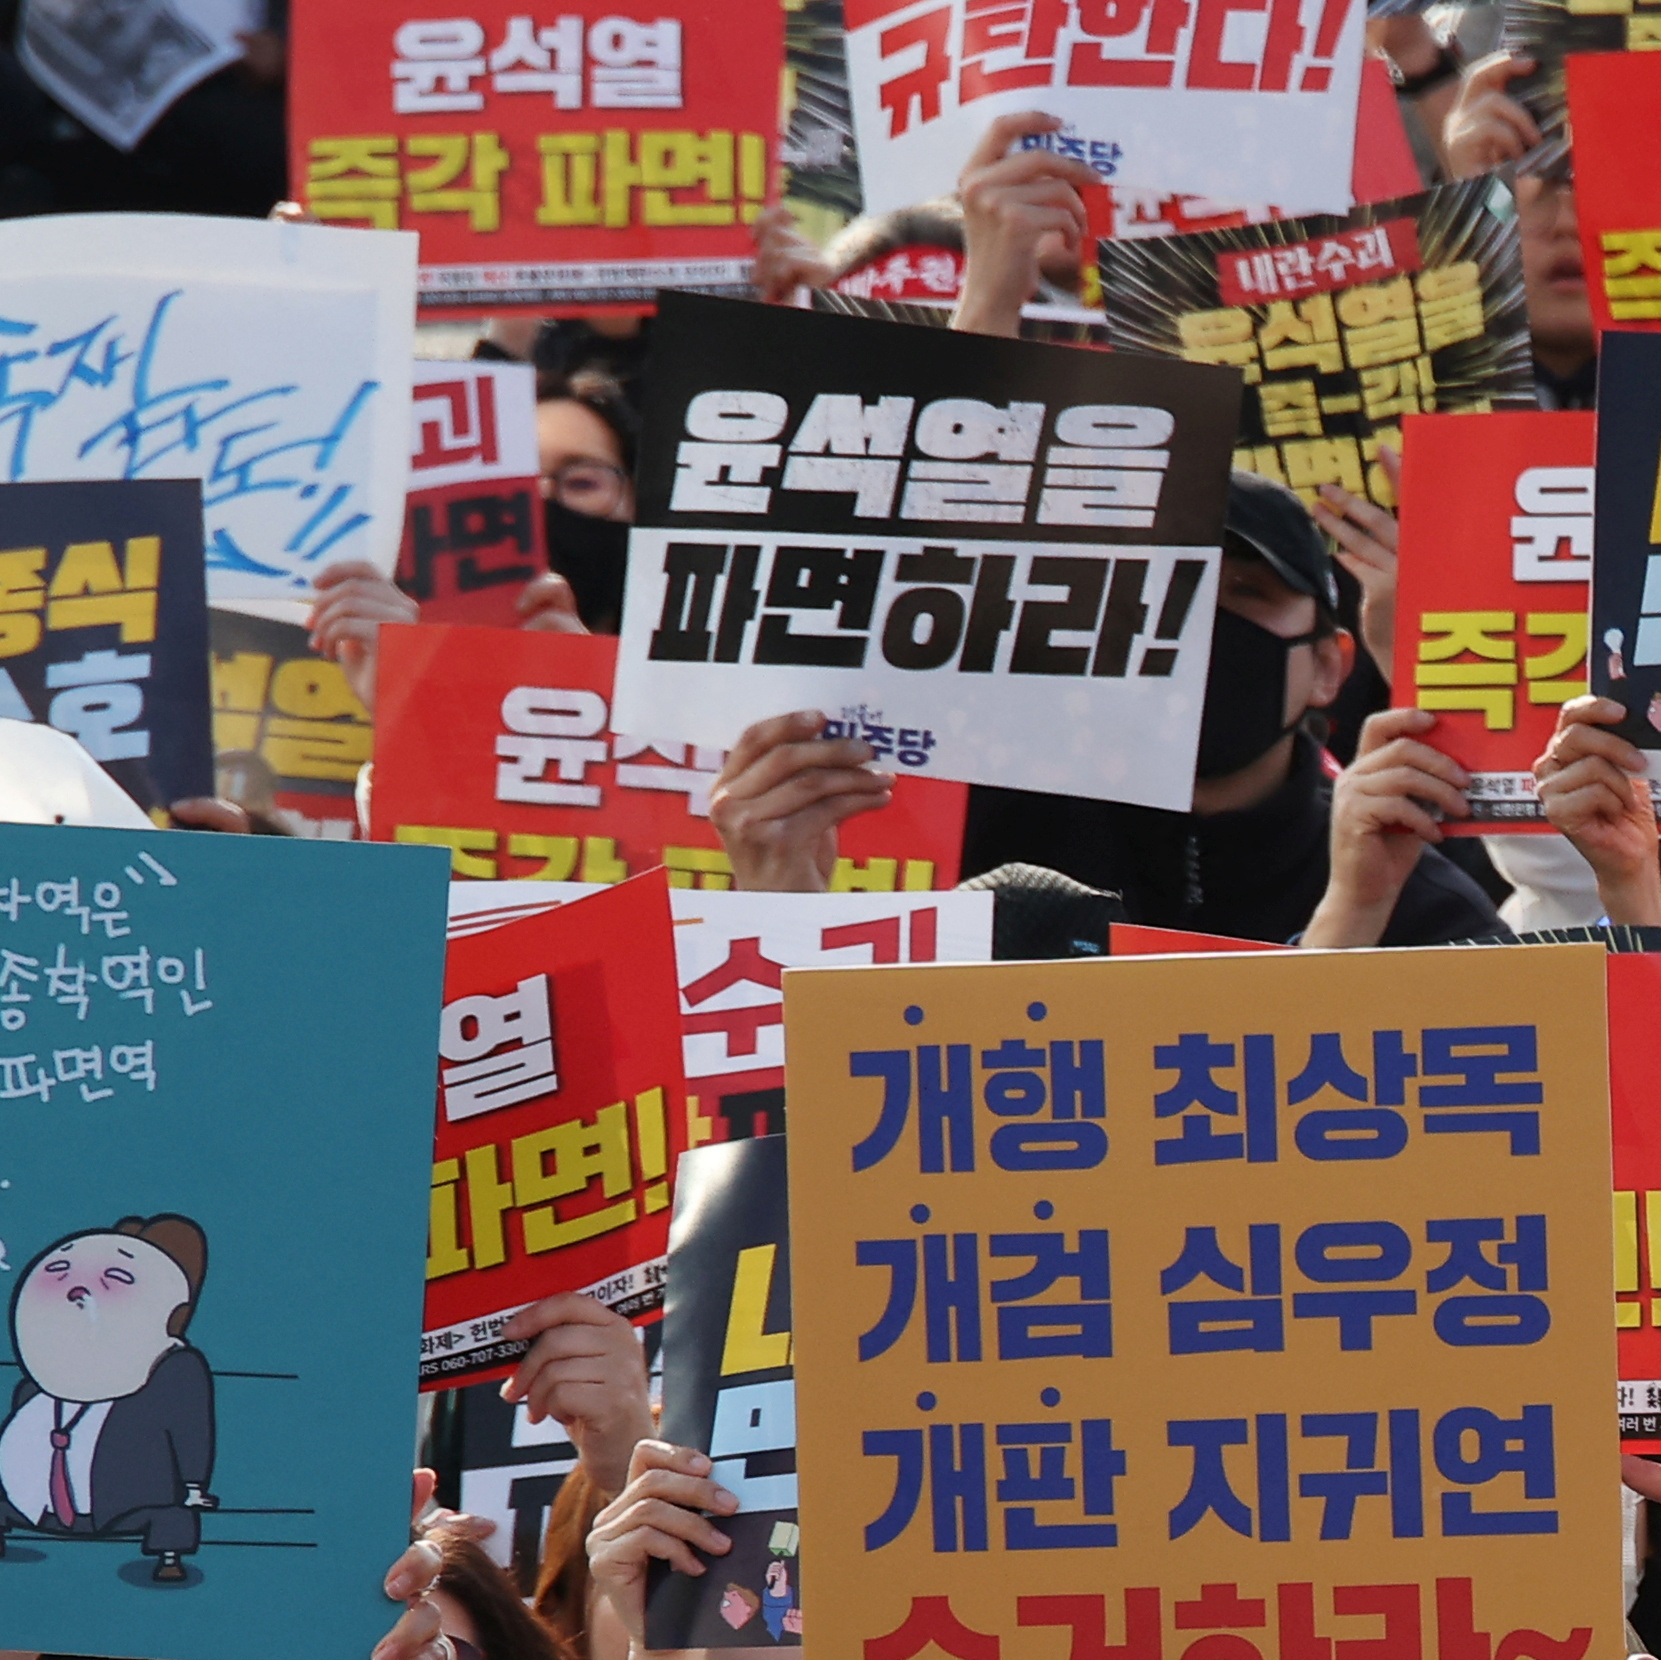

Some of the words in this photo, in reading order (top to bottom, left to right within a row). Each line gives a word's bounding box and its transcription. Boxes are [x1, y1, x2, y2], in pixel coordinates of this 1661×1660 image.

[390, 15, 684, 115] 윤석열
[304, 132, 508, 233] 즉각
[536, 129, 768, 230] 파면!
[1235, 228, 1394, 297] 내란수괴
[669, 388, 1176, 529] 윤석열을
[646, 540, 1210, 680] 파면하라!
[849, 1038, 1112, 1175] 개행
[1152, 1024, 1545, 1168] 최상목
[855, 1226, 1116, 1364] 개검
[1160, 1213, 1554, 1356] 심우정
[861, 1412, 1128, 1554] 개판
[1167, 1403, 1560, 1545] 지귀연
